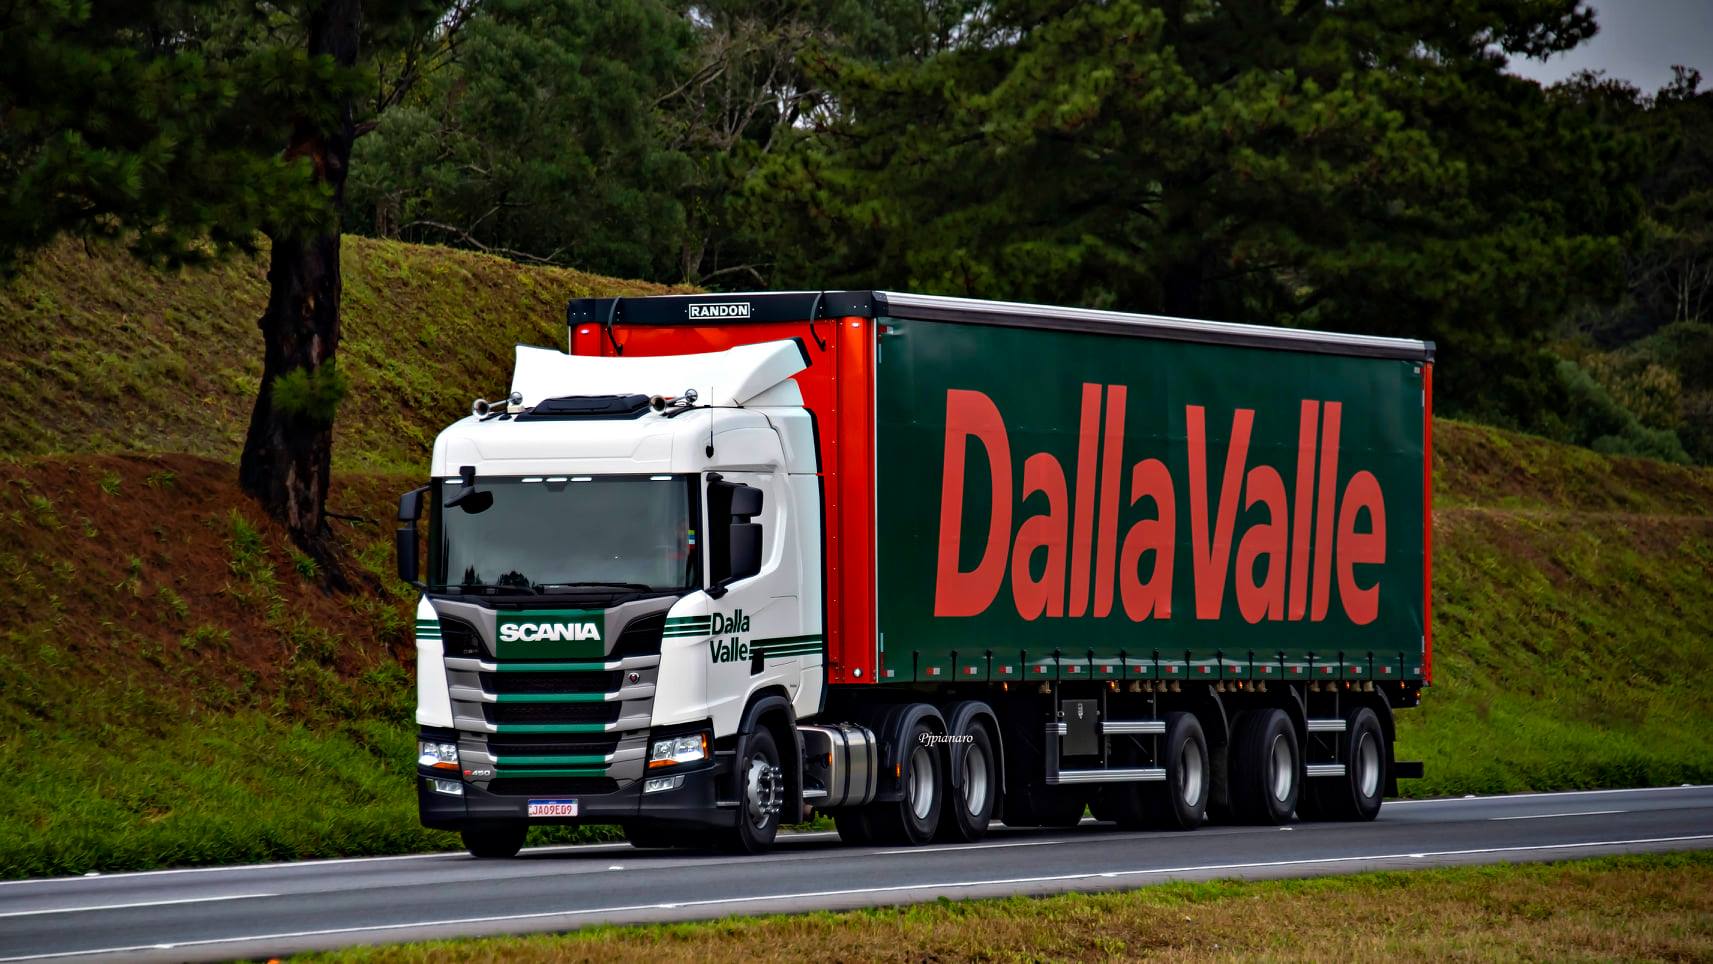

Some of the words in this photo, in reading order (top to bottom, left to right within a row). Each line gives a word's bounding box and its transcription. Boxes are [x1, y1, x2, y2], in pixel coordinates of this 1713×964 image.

[691, 305, 748, 317] RANDON
[934, 383, 1176, 622] Dalla
[1186, 399, 1387, 625] Valle
[500, 623, 601, 642] SCANIA
[712, 608, 750, 635] Dalla
[710, 637, 748, 663] Valle
